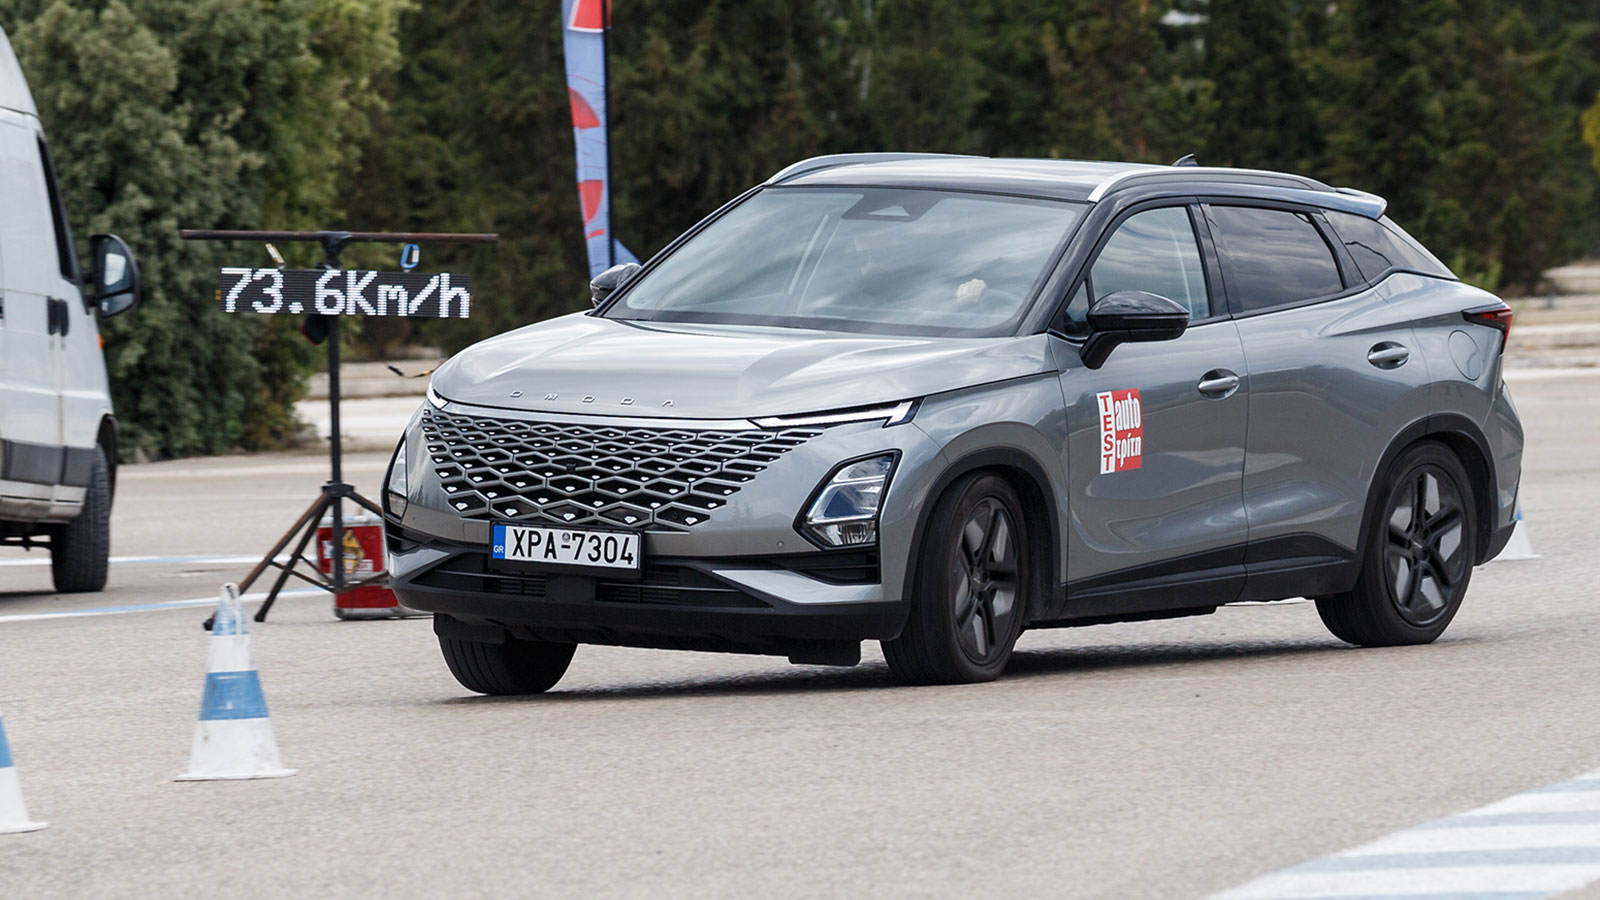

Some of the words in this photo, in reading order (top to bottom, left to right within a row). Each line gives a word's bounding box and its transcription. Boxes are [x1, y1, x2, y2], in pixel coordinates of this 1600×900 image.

[221, 268, 470, 318] 73.6Km/h
[510, 390, 674, 408] OMODA
[1115, 392, 1141, 432] auto
[1100, 395, 1113, 471] TEST
[493, 545, 505, 554] GR
[512, 529, 634, 565] XPA-7304
